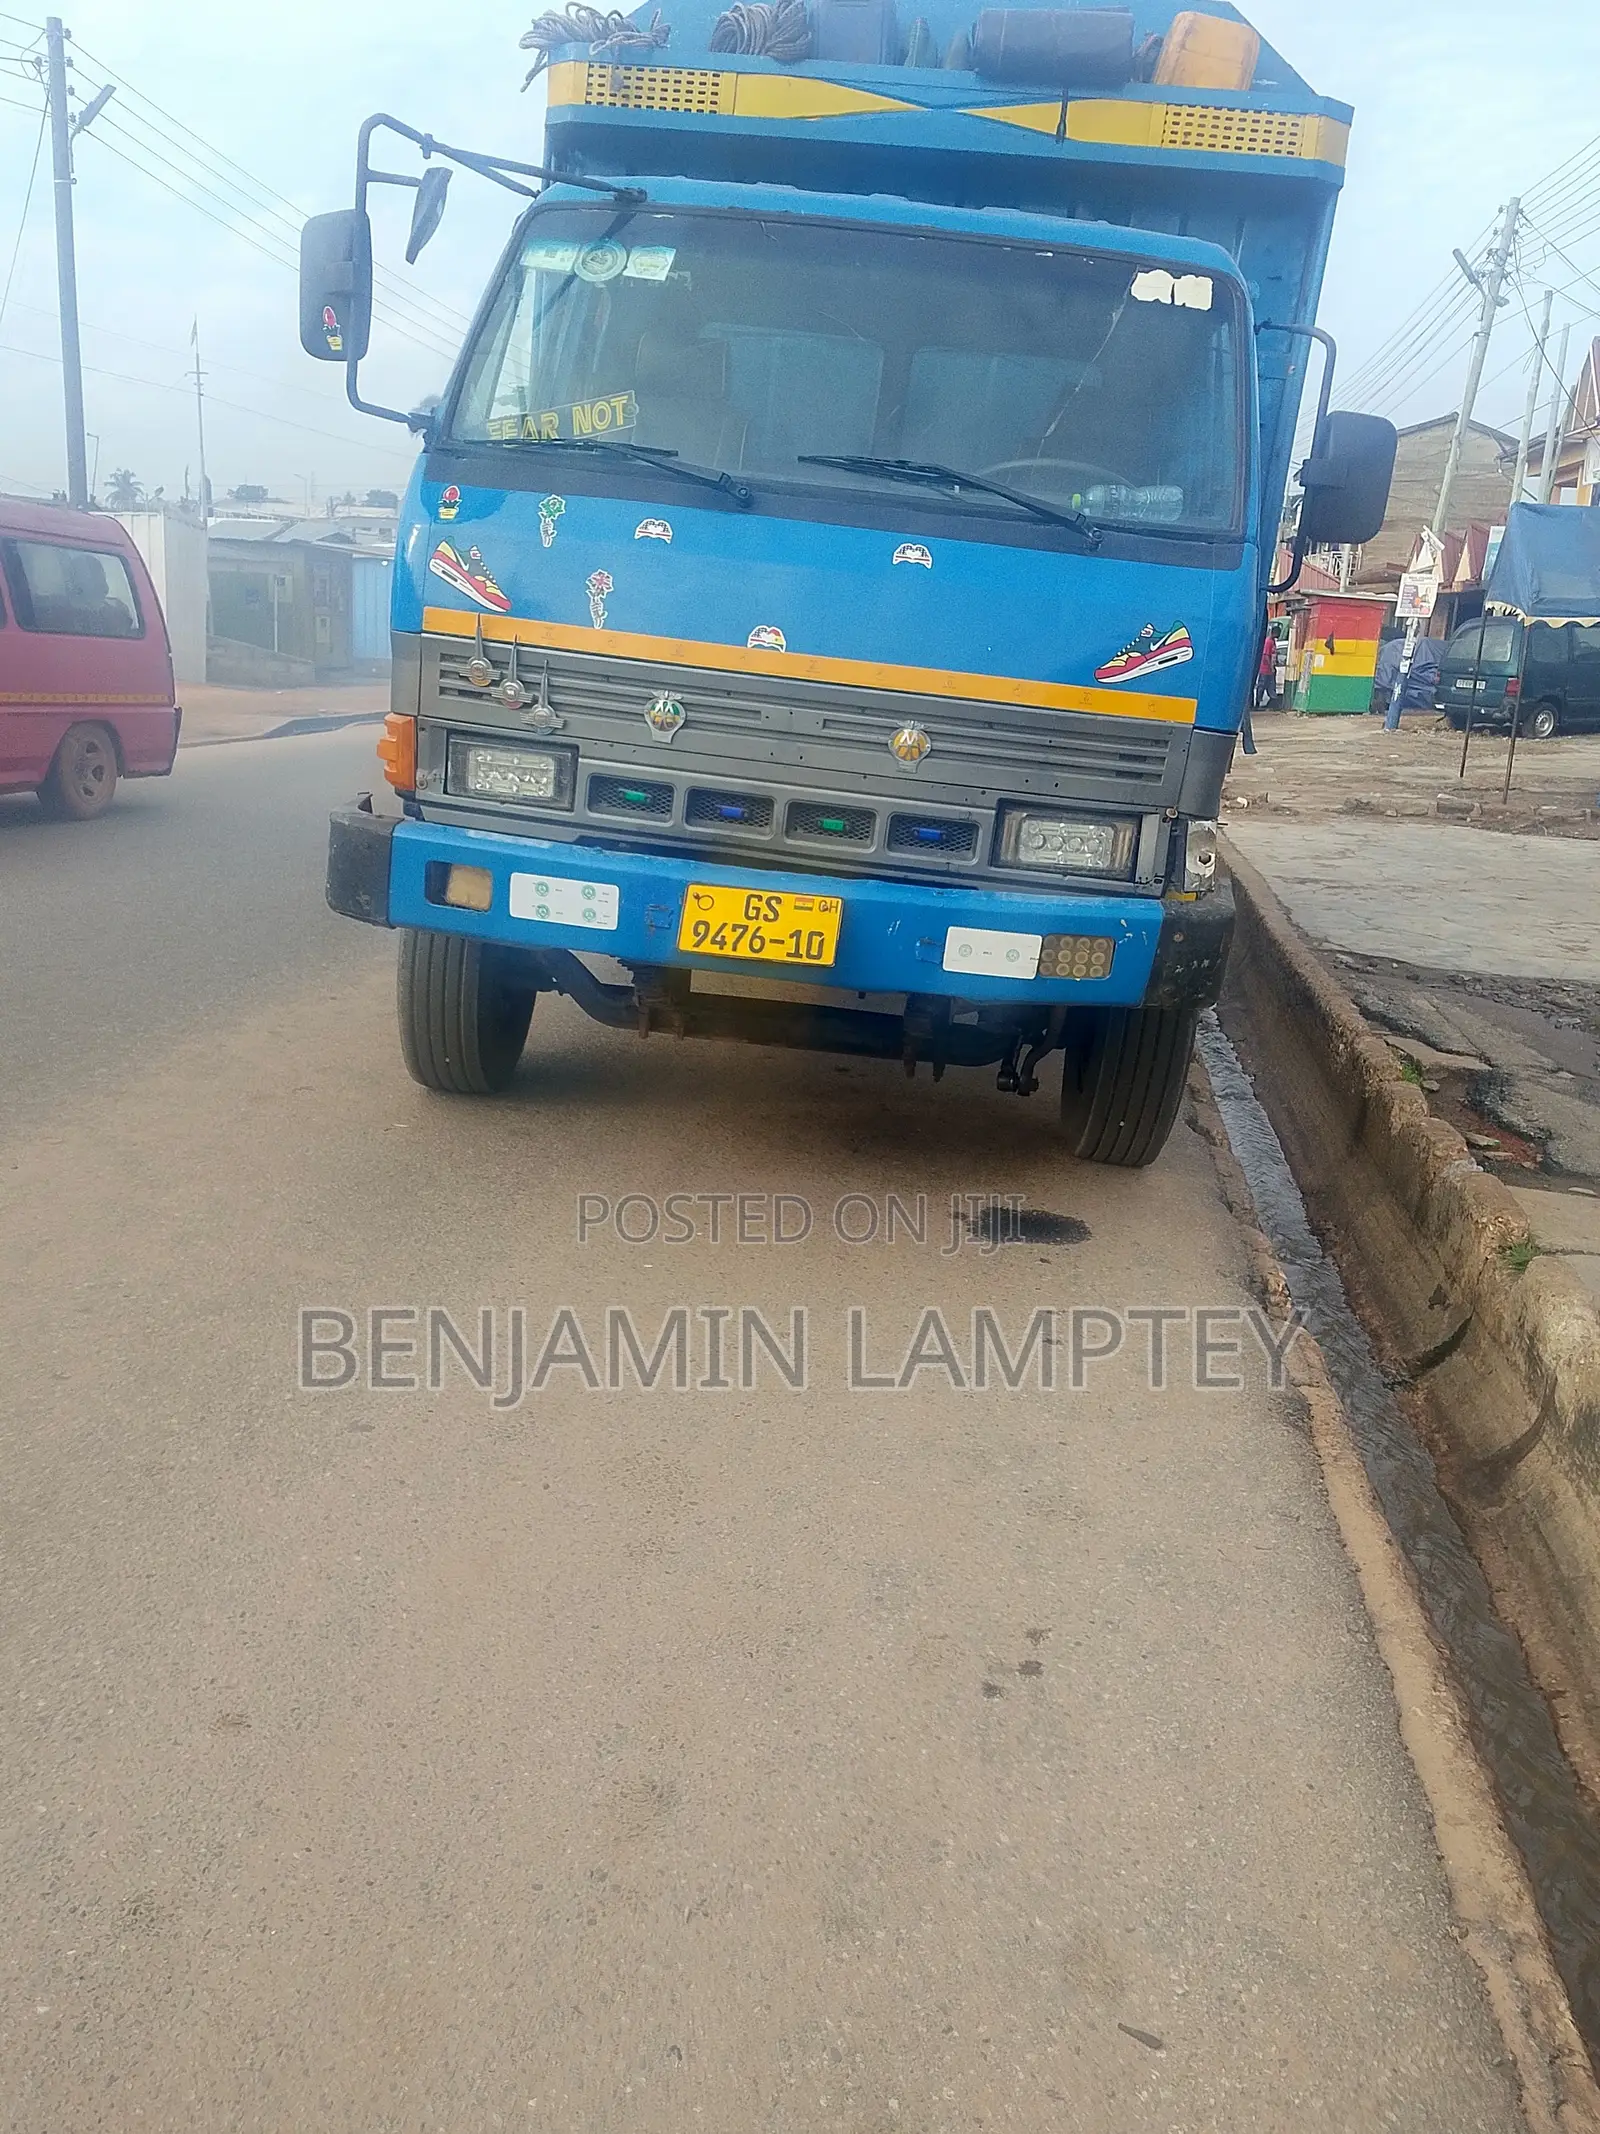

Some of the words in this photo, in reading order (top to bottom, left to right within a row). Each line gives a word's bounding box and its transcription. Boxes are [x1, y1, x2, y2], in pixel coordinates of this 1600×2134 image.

[487, 411, 559, 442] FEAR
[572, 395, 629, 436] NOT
[744, 894, 783, 923] GS
[818, 900, 839, 914] GH
[692, 920, 825, 961] 9476-10
